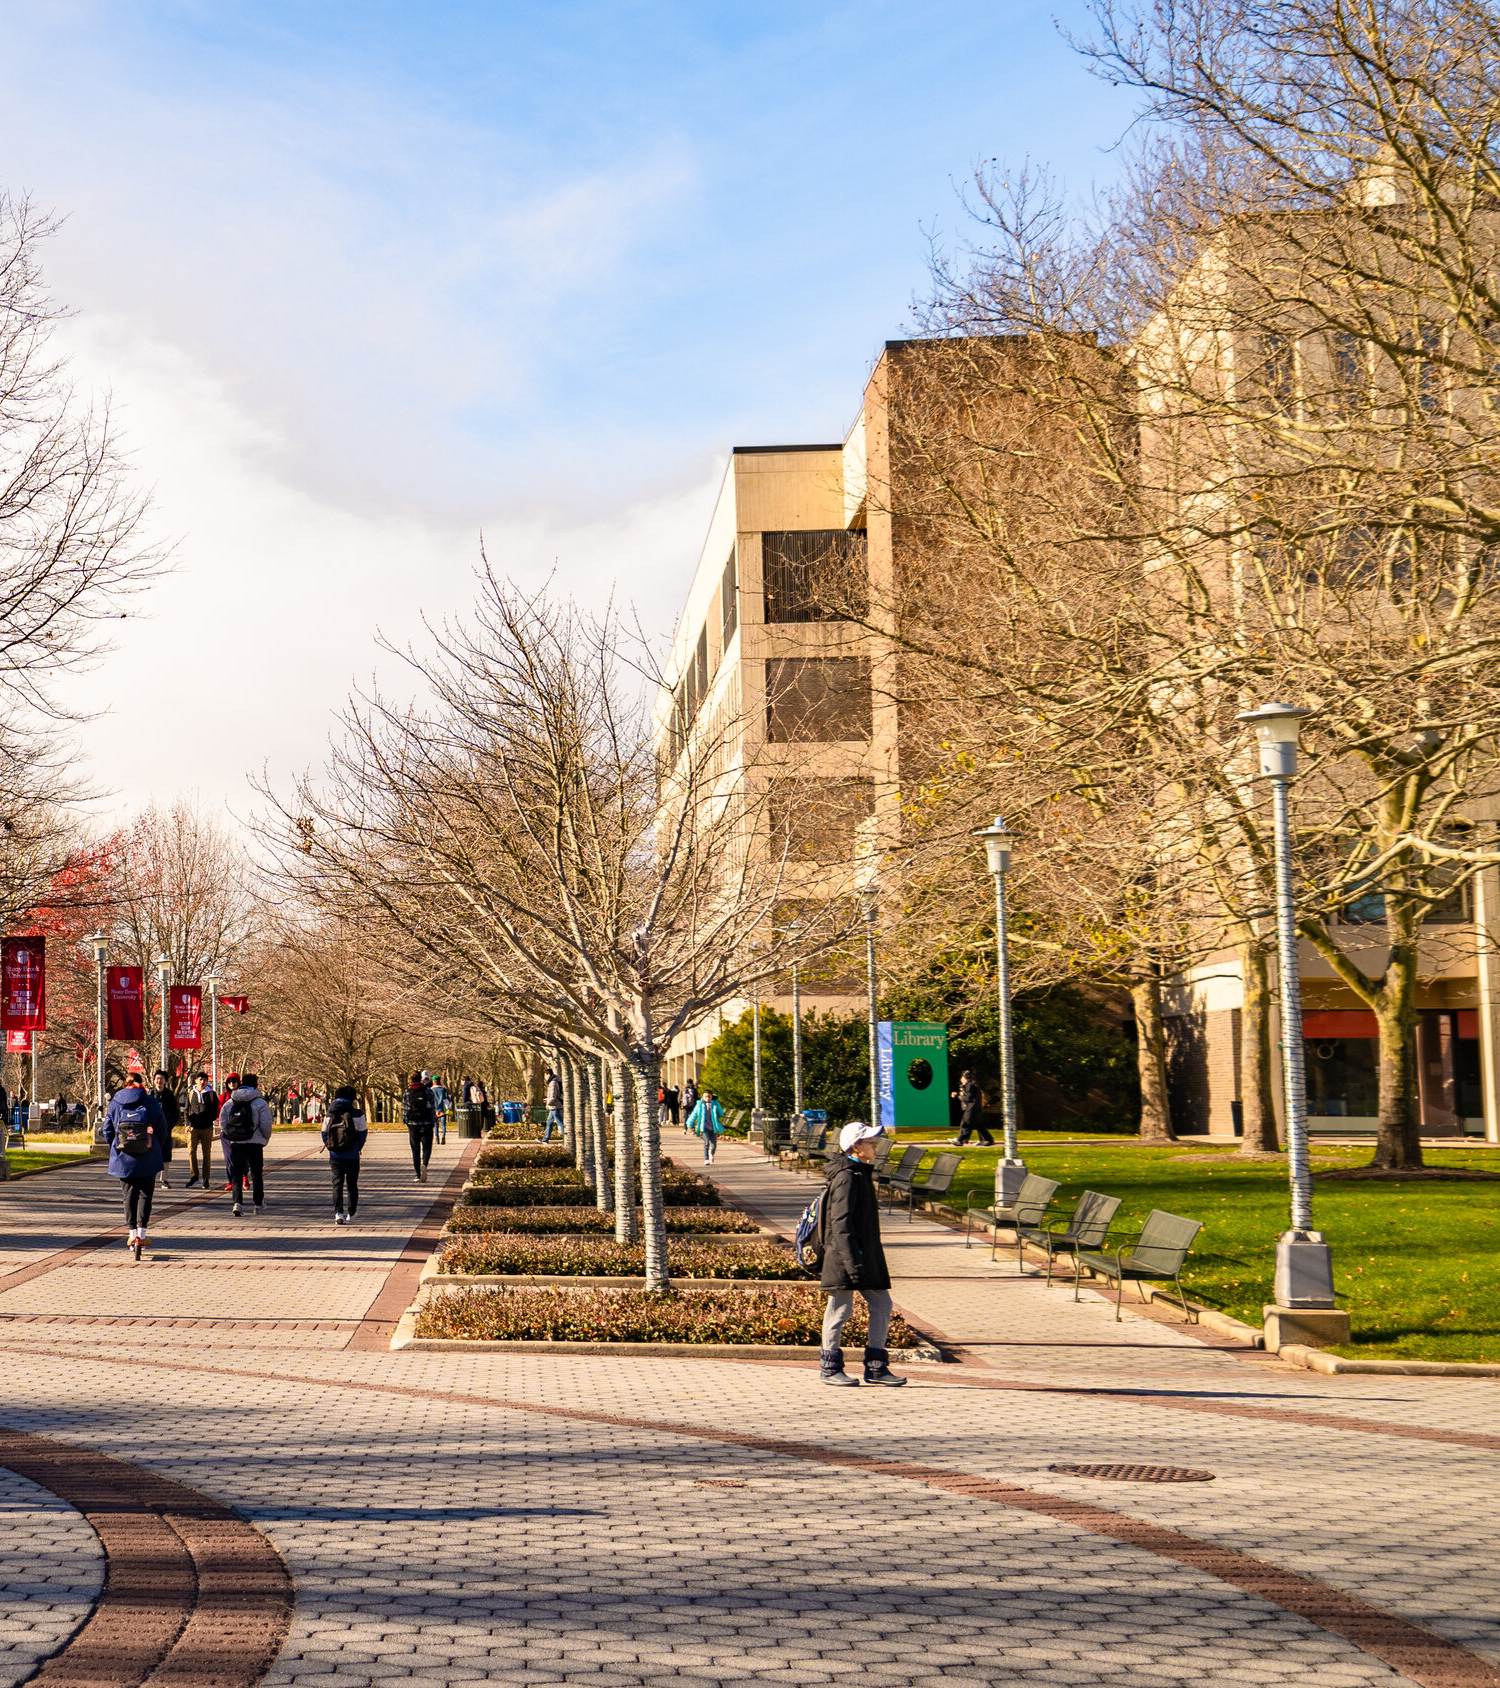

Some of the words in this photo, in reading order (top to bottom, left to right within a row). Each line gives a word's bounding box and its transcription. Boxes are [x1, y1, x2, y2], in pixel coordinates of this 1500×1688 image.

[5, 966, 21, 974] Stony
[893, 1031, 945, 1050] Library
[880, 1048, 893, 1100] Library
